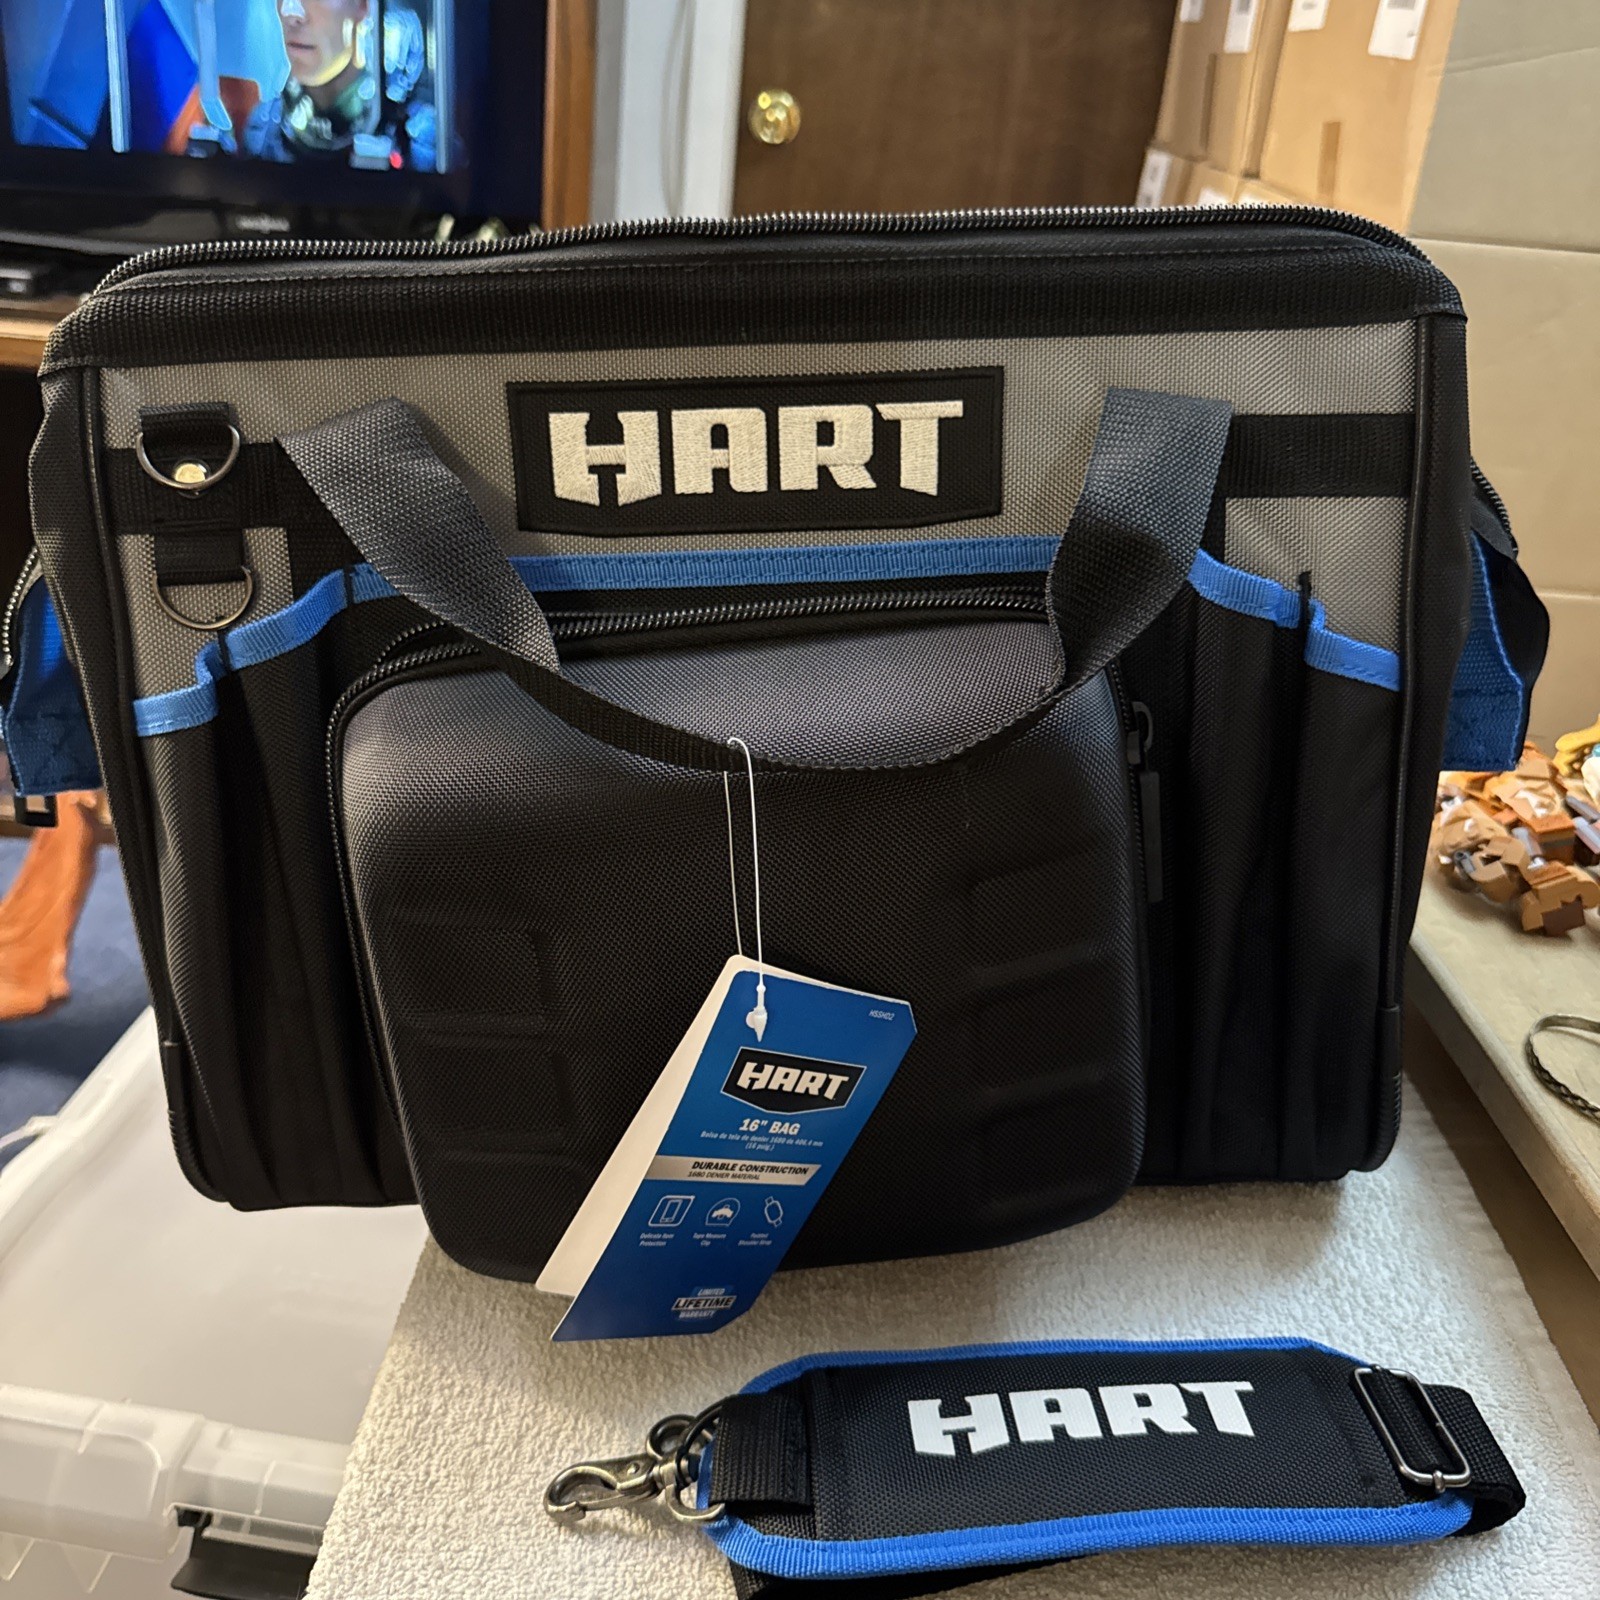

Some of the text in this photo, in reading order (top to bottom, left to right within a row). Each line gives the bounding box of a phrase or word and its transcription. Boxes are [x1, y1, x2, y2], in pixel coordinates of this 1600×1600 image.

[549, 401, 963, 506] HART
[737, 1062, 849, 1100] HART
[739, 1118, 801, 1135] 16" BAG
[691, 1161, 809, 1175] DURABLE CONSTRUCTION
[675, 1297, 734, 1308] LIFETIME
[908, 1381, 1255, 1457] HART
